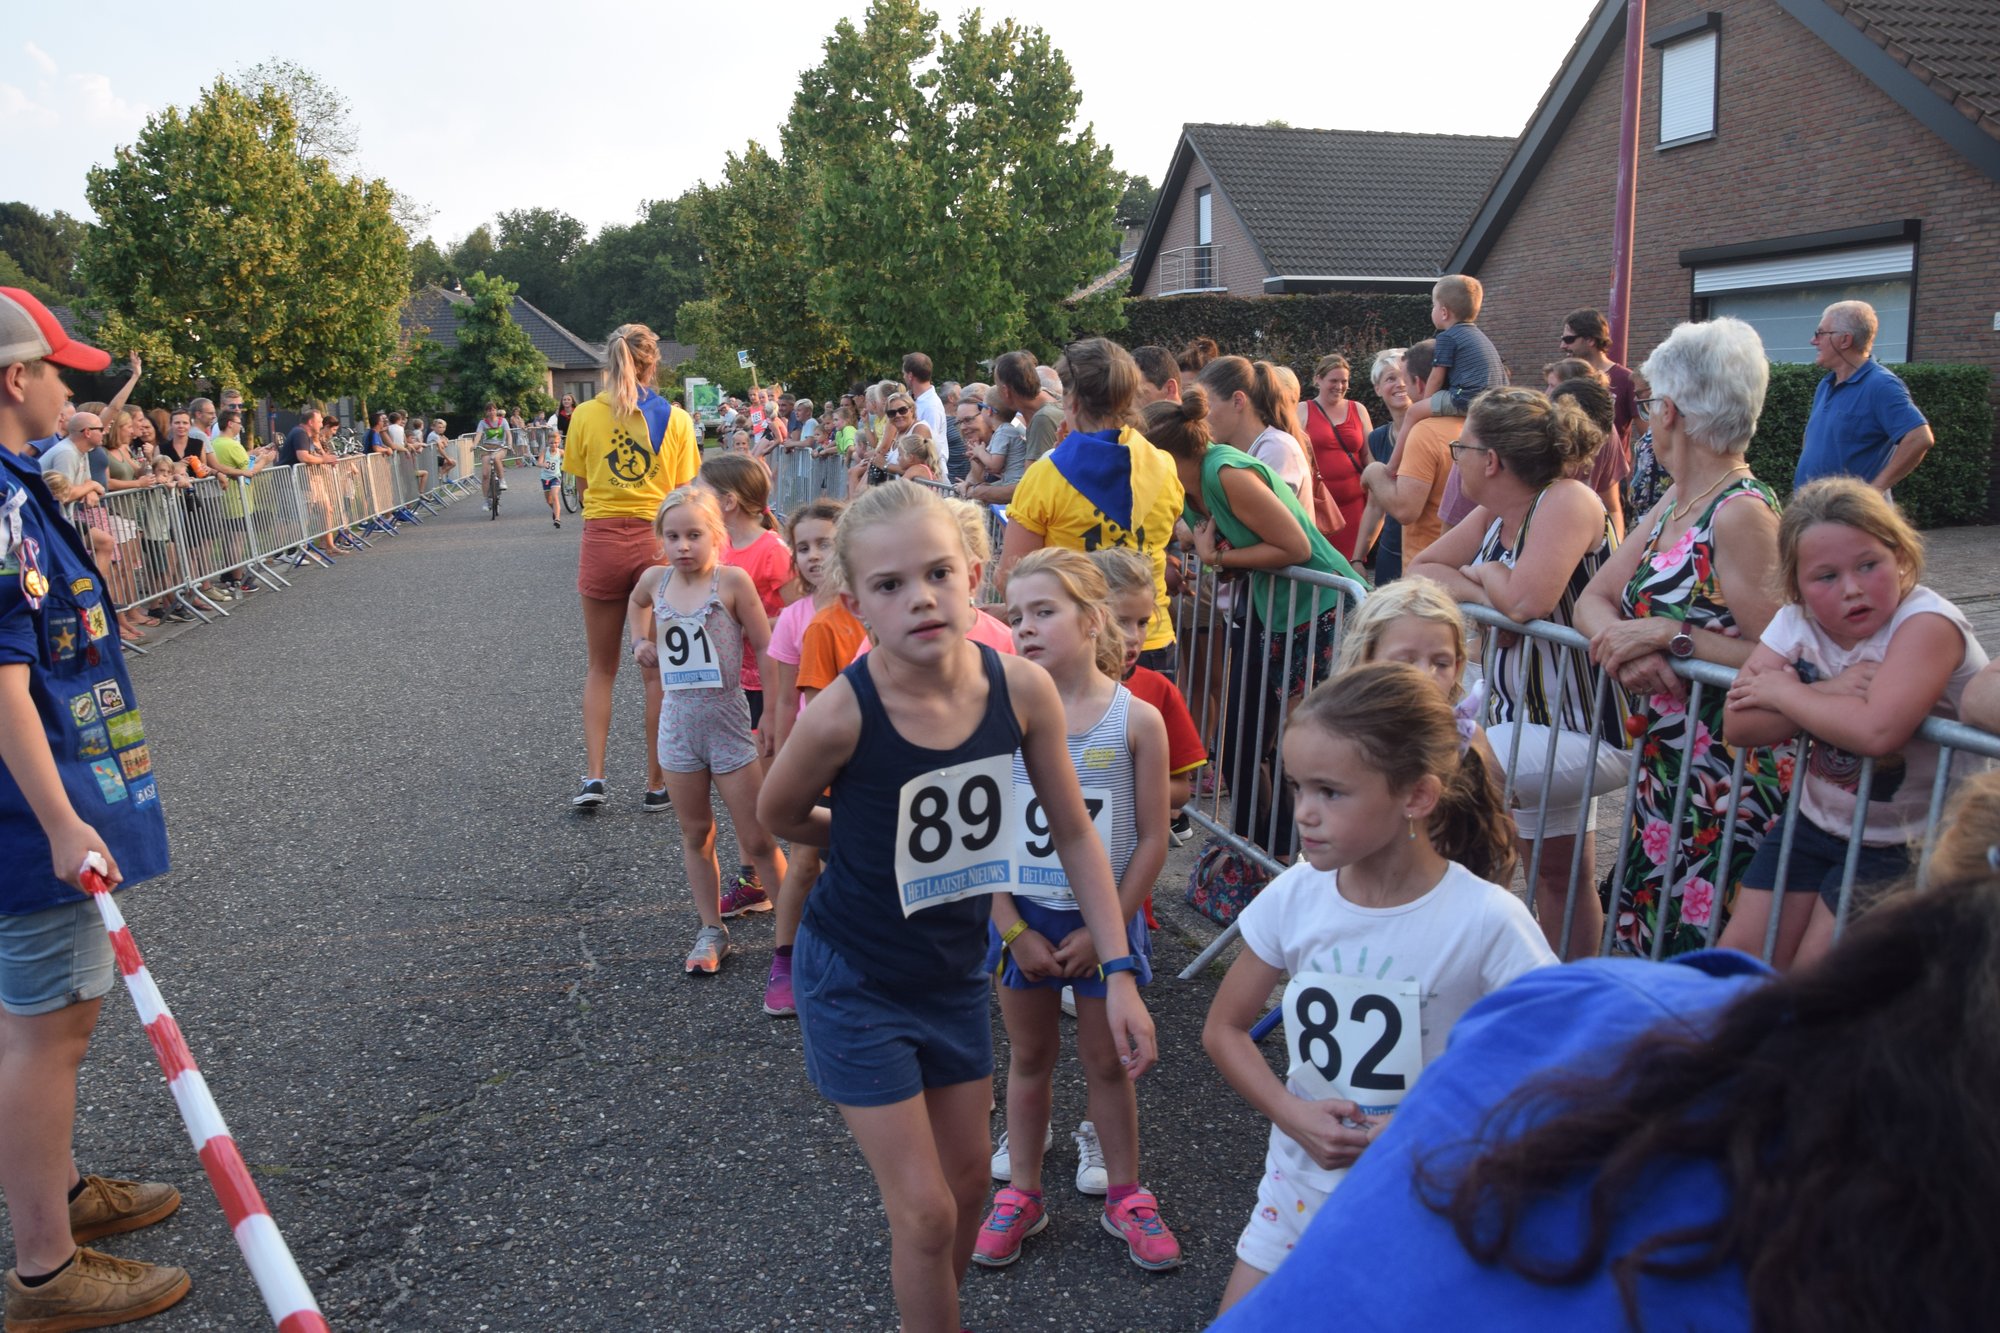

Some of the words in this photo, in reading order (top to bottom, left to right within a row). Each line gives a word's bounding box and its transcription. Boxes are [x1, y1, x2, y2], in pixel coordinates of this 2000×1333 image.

[665, 625, 711, 666] 91
[908, 774, 1002, 864] 89
[907, 882, 926, 902] HET
[926, 871, 967, 896] LAATSTE
[968, 864, 1005, 885] NIEUWS
[1023, 867, 1038, 883] HET
[1039, 868, 1069, 886] LAATST
[1296, 986, 1405, 1091] 82
